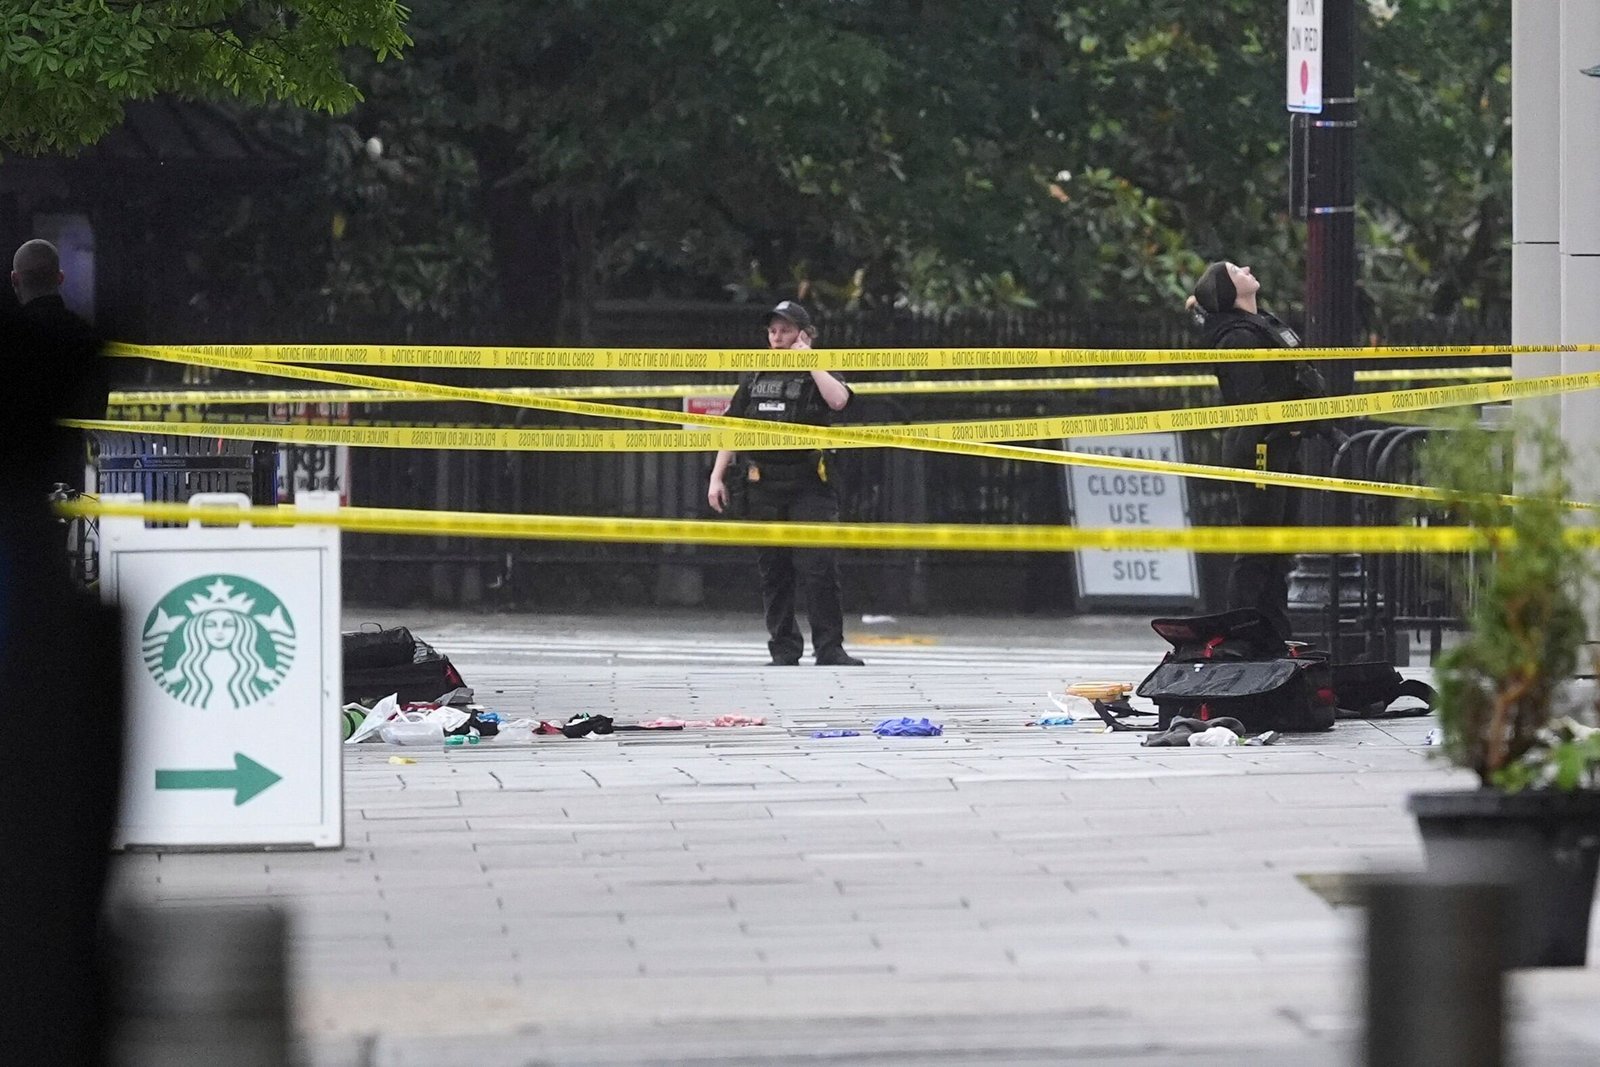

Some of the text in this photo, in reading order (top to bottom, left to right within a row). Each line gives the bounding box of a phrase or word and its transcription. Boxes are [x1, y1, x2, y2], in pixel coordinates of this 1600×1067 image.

[1291, 27, 1318, 51] ON RED
[752, 384, 781, 394] POLICE
[1087, 474, 1166, 496] CLOSED
[1108, 503, 1150, 524] USE
[1113, 560, 1162, 582] SIDE
